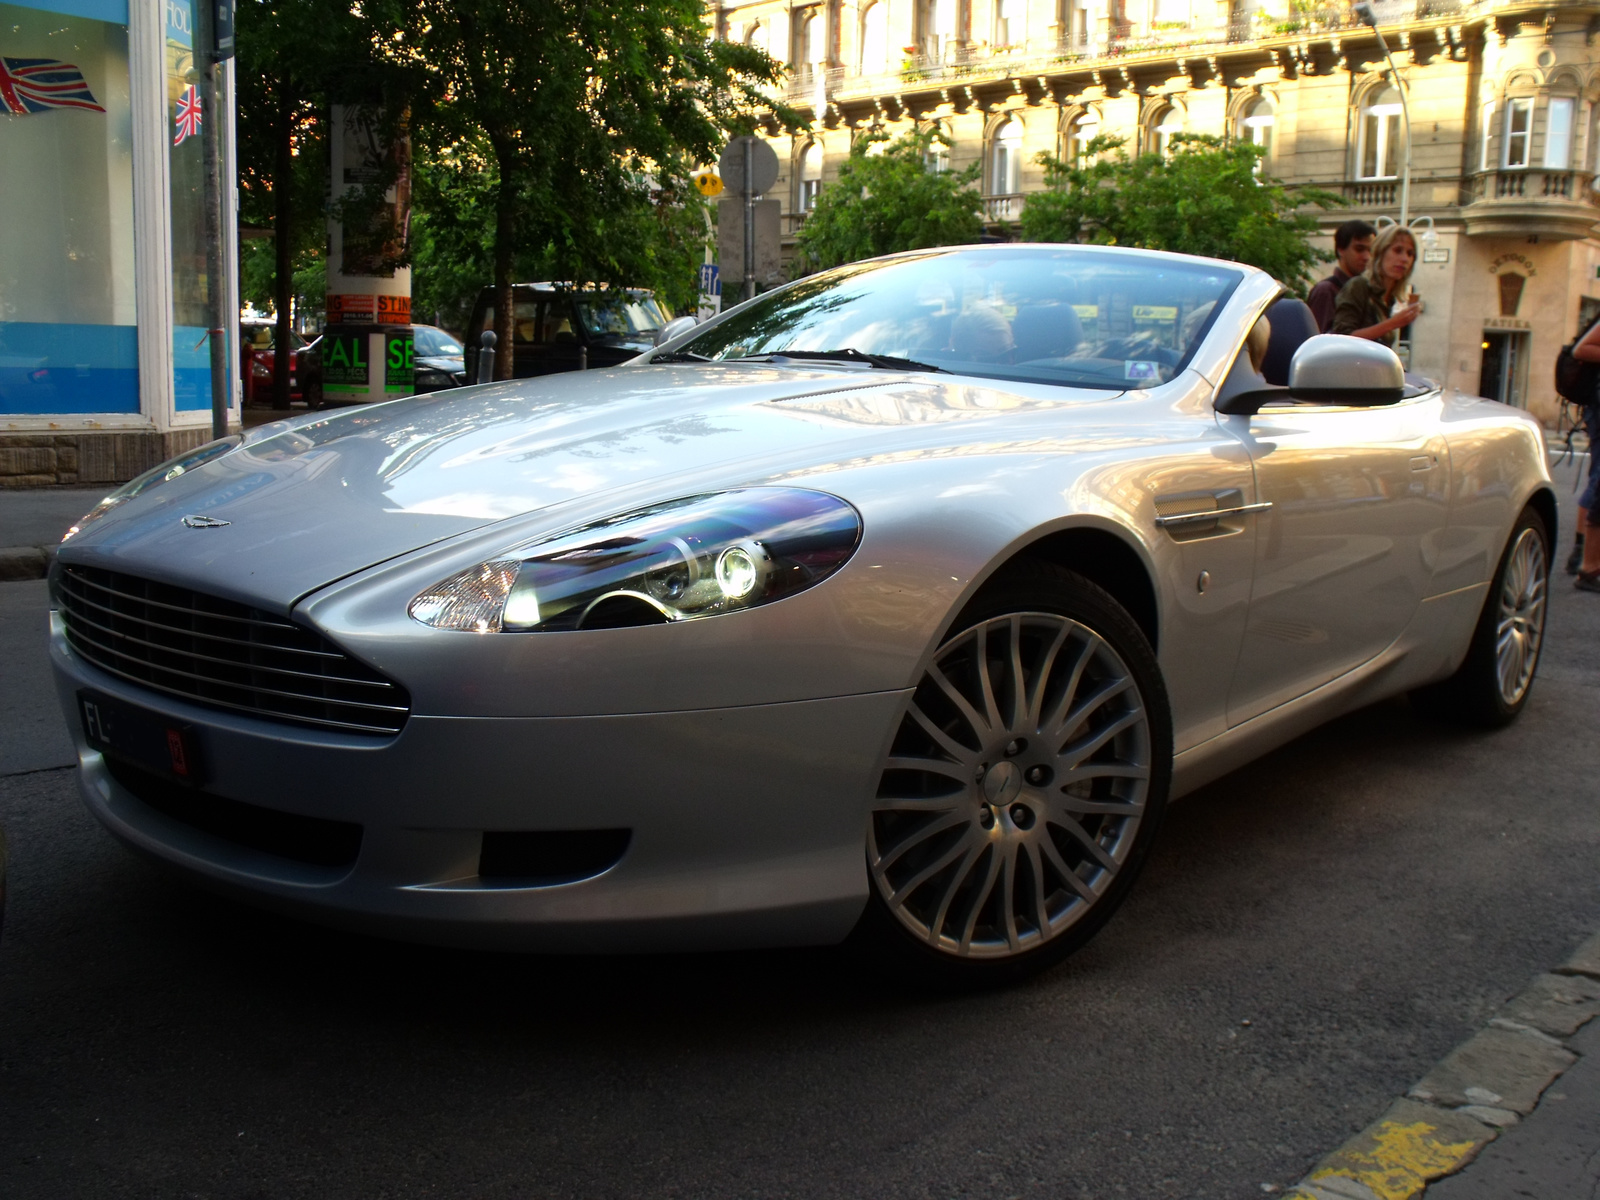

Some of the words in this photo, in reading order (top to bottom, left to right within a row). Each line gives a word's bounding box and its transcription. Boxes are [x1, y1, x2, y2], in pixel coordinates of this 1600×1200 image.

[1488, 253, 1537, 277] OKTOGON
[1483, 318, 1531, 328] PATIKA
[322, 337, 367, 367] EAL
[387, 338, 414, 369] SE
